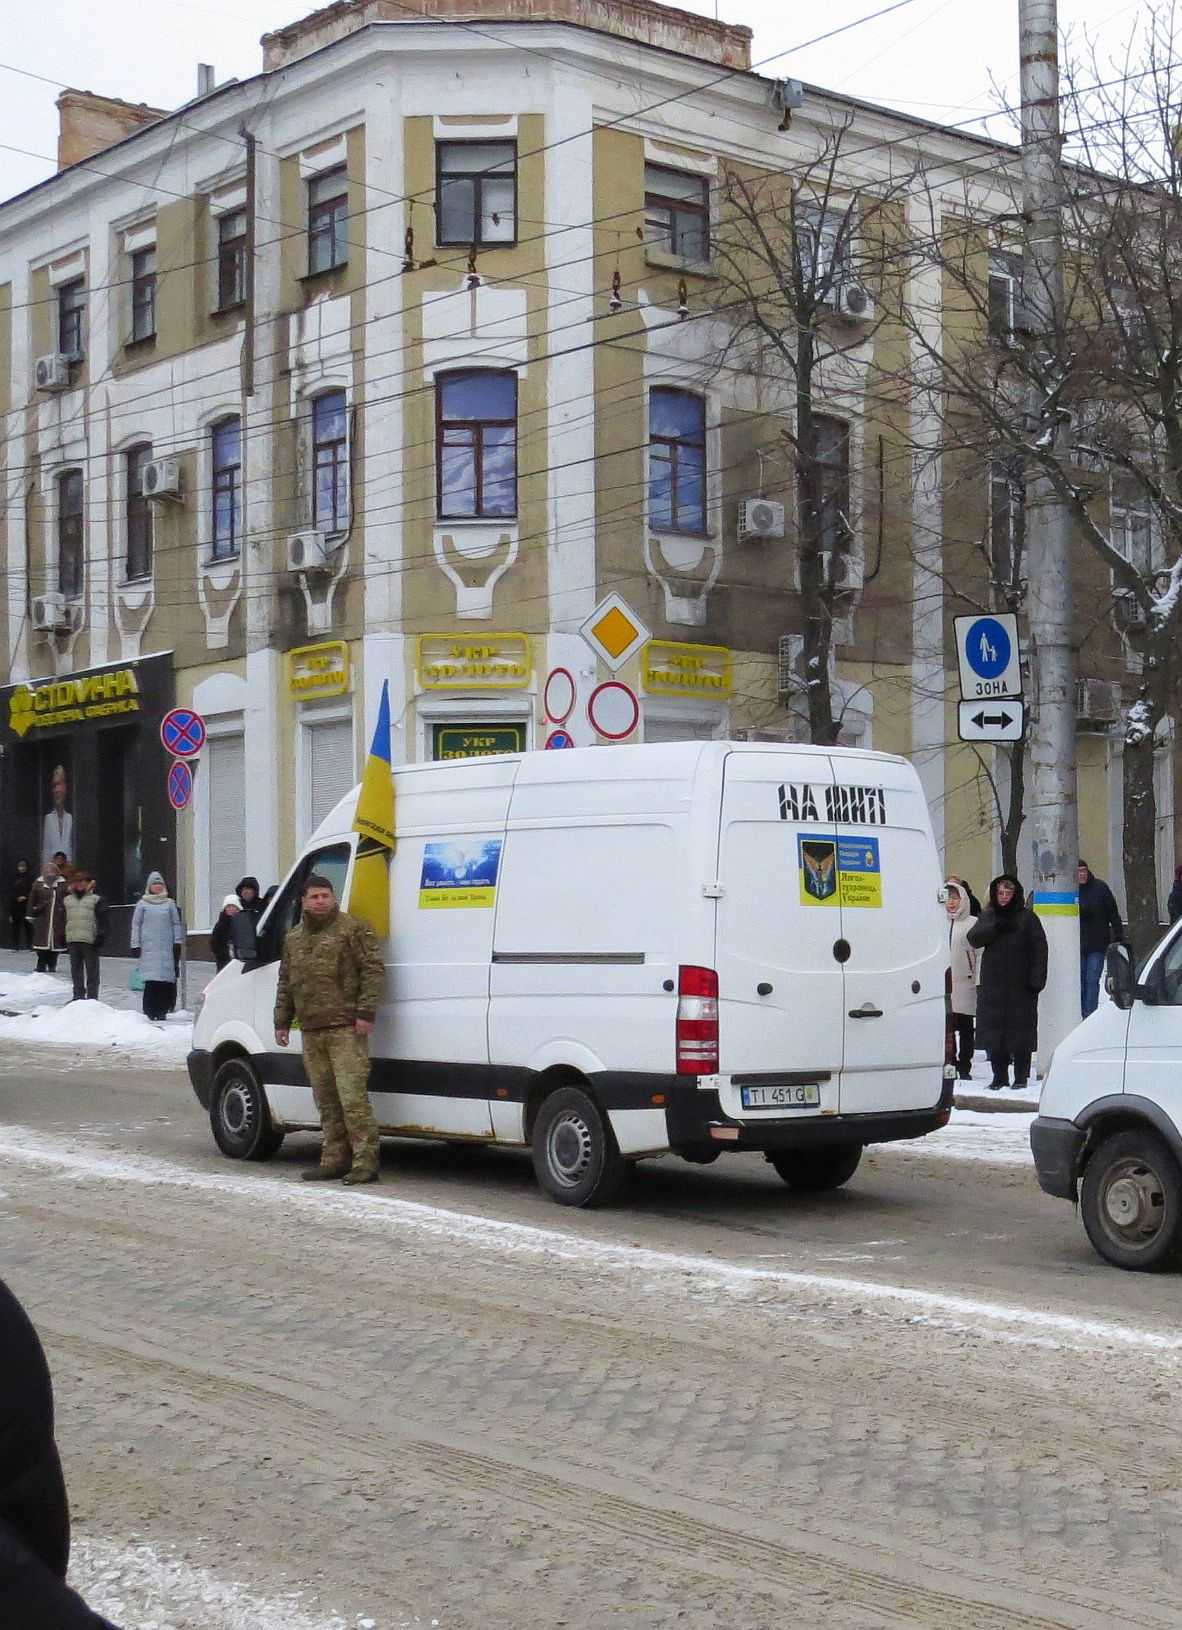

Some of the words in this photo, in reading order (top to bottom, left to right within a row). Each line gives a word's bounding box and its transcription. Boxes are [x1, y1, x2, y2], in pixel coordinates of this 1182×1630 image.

[975, 680, 1009, 696] ЗОНА
[463, 736, 497, 748] УКР
[777, 783, 819, 821] НА
